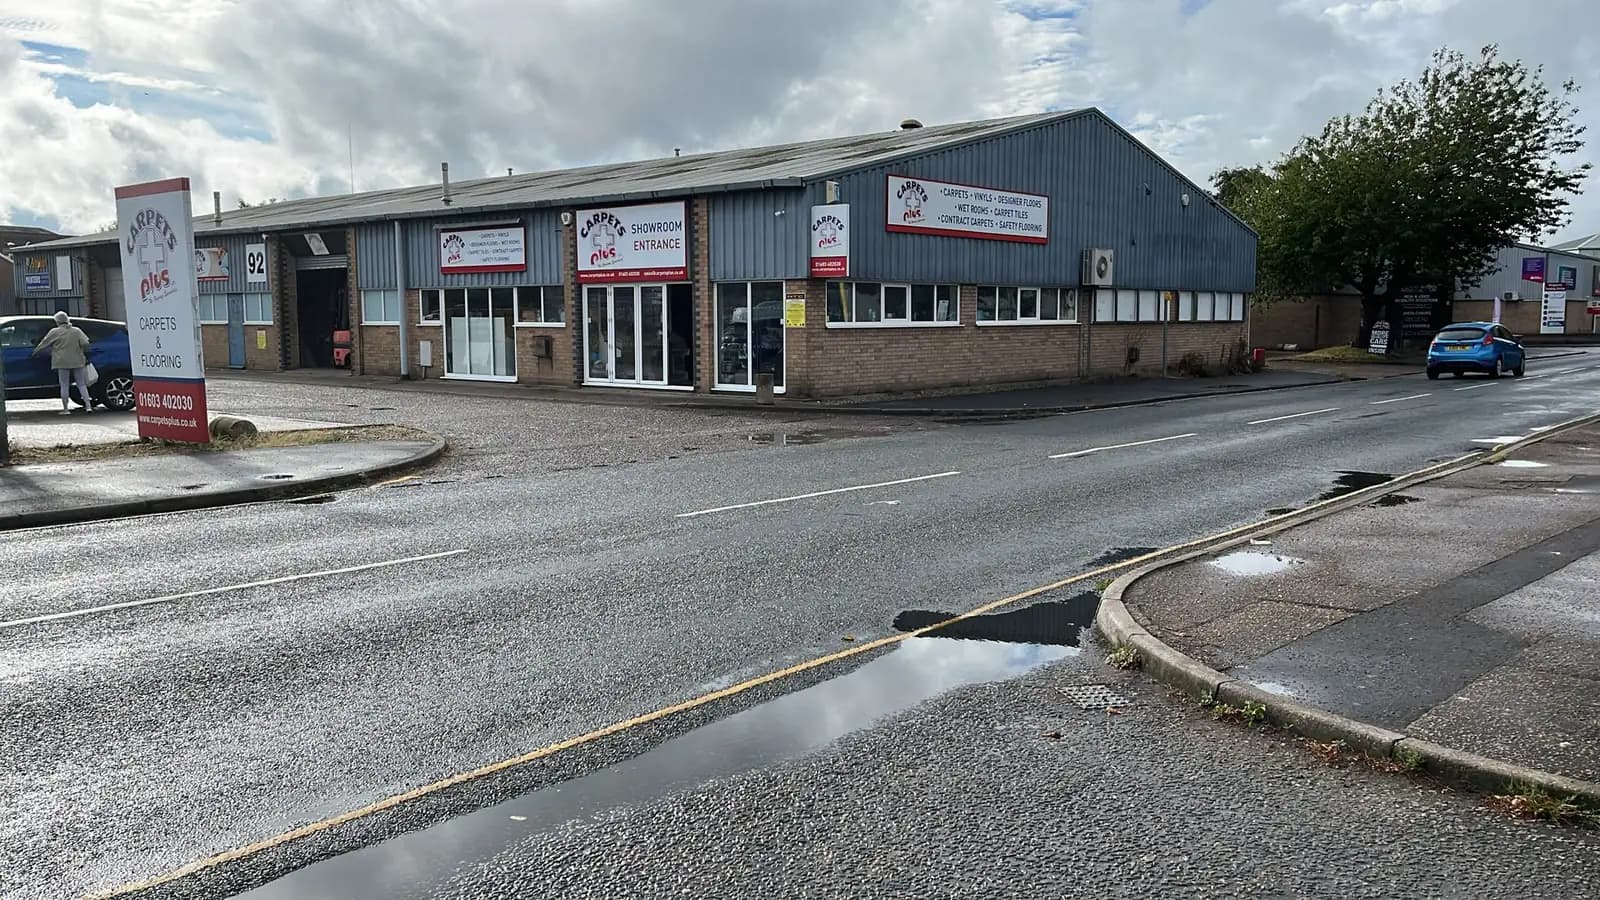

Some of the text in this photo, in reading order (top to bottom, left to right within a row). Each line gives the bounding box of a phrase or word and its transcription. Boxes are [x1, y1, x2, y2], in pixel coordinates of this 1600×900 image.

[897, 181, 928, 202] CARPETS
[944, 188, 1042, 208] CARPETS VINYLS DESIGNER FLOORS
[958, 204, 1028, 219] WET ROOMS CARPET TILES
[580, 212, 626, 238] CARPETS
[632, 220, 682, 234] SHOWROOM
[812, 216, 844, 232] CARPETS
[941, 214, 1042, 232] CONTRACT CARPETS SAFETY FLOORING
[127, 209, 177, 254] CARPETS
[442, 234, 466, 248] CARPETS
[634, 238, 680, 251] ENTRANCE
[248, 252, 264, 274] 92
[141, 269, 170, 300] plus
[140, 317, 176, 330] CARPETS
[156, 336, 162, 349] &
[141, 354, 182, 368] FLOORING
[140, 392, 192, 410] 01603 402030
[140, 415, 198, 428] www.carpetsplus.co.uk
